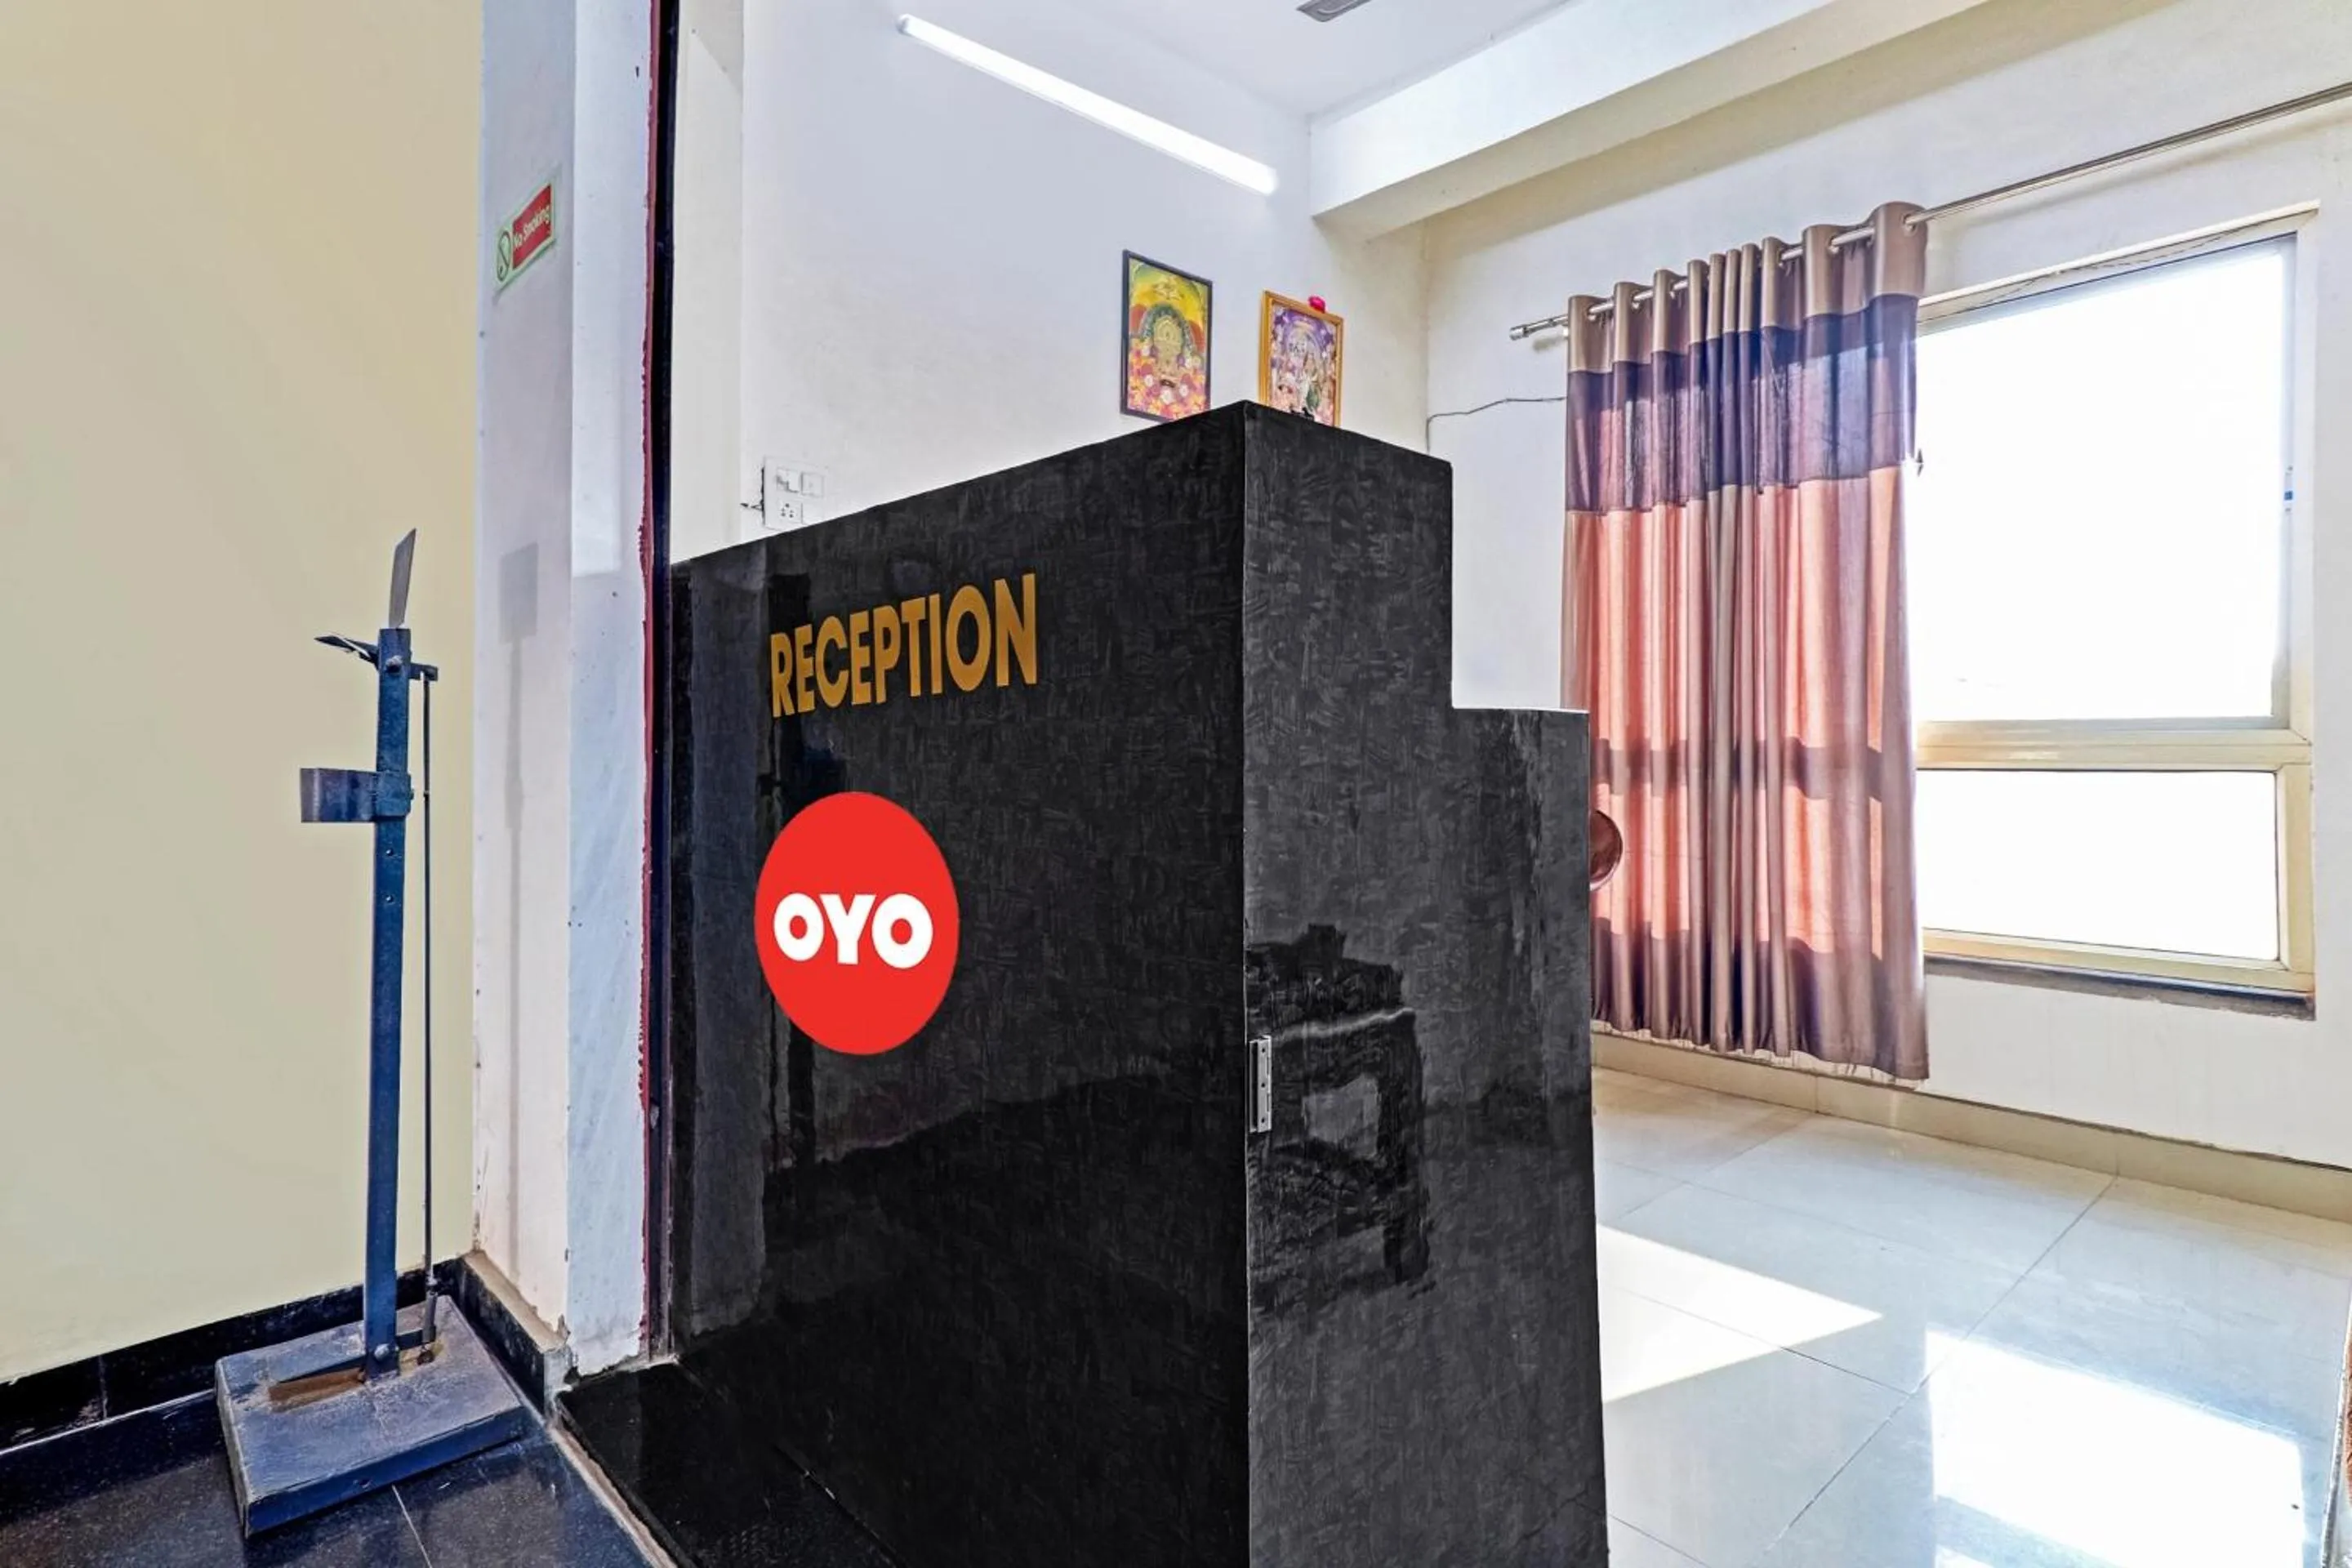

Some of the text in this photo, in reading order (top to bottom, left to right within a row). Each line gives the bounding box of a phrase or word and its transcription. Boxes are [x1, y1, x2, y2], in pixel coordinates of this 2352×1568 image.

[514, 232, 523, 248] No
[770, 573, 1037, 717] RECEPTION
[773, 893, 933, 969] OYO
